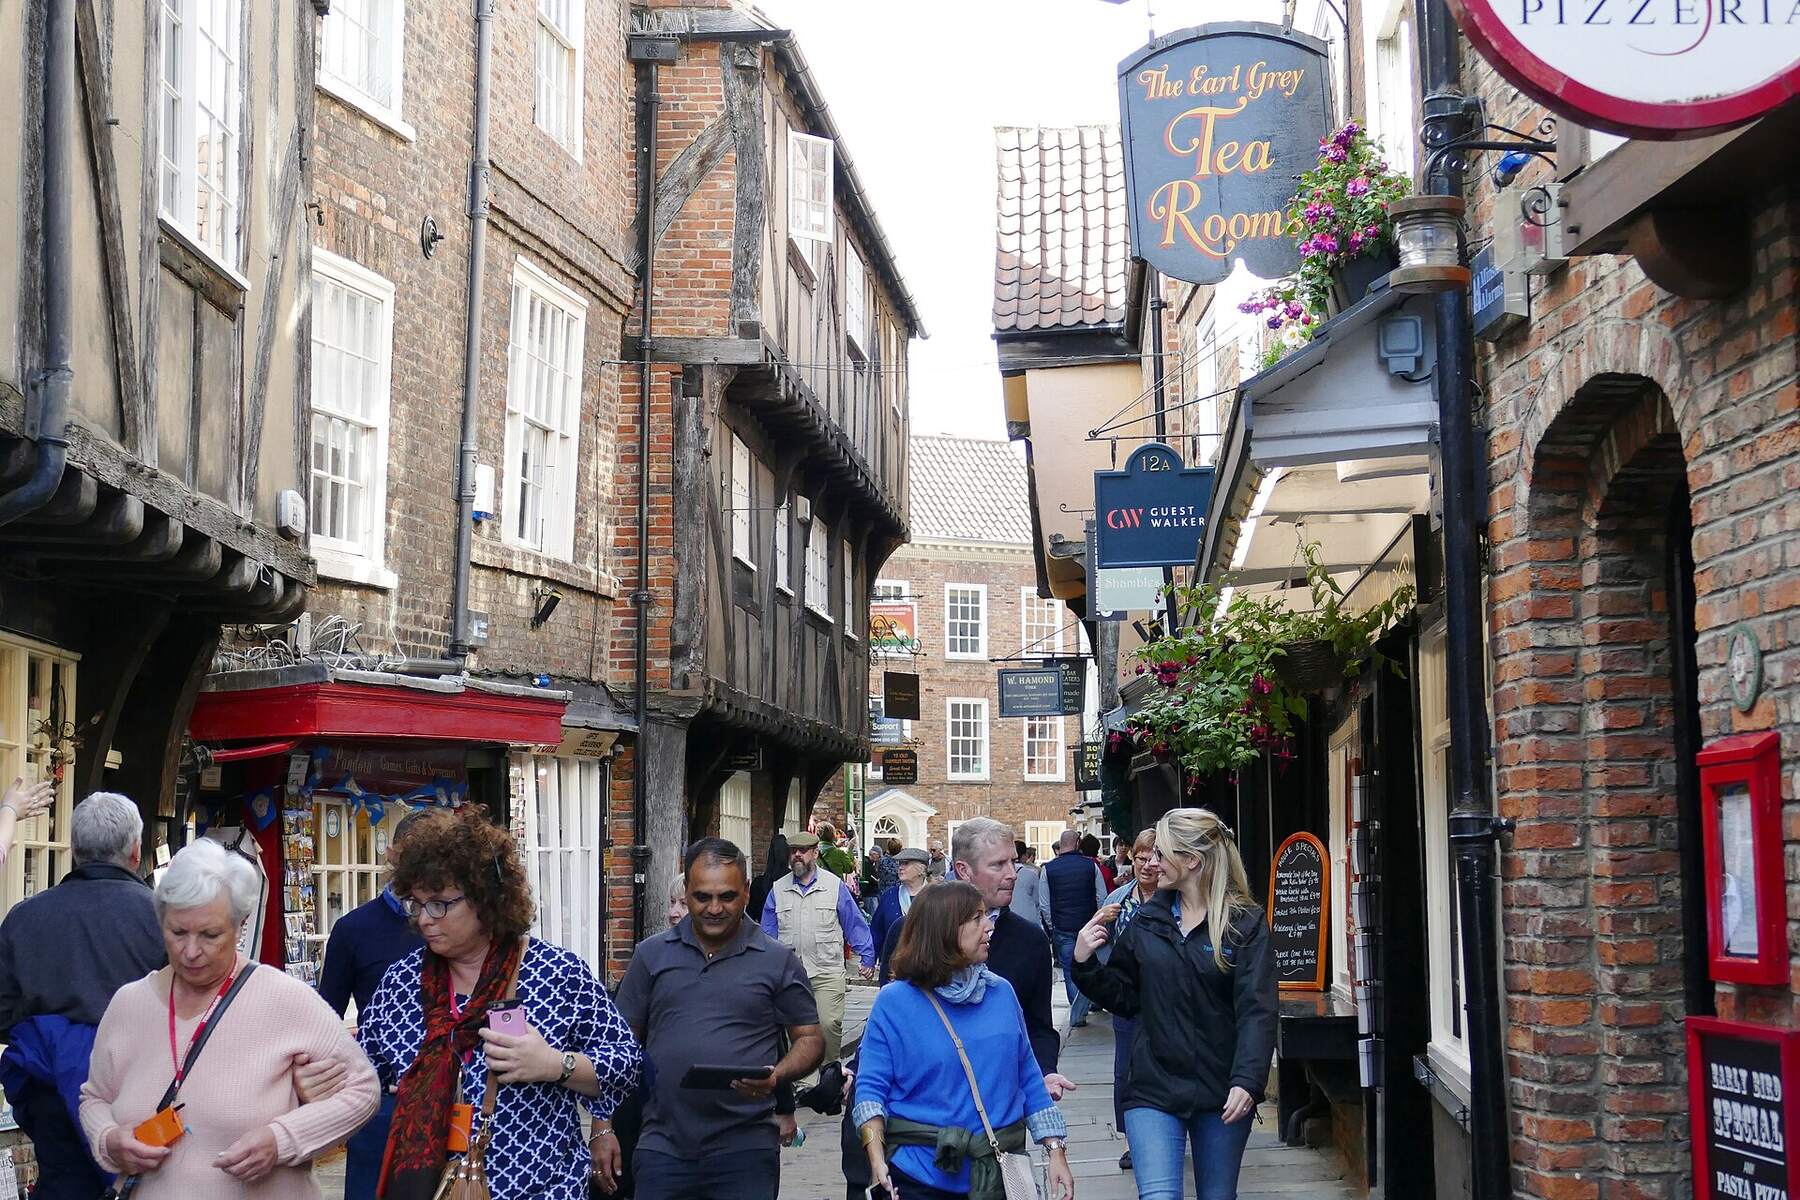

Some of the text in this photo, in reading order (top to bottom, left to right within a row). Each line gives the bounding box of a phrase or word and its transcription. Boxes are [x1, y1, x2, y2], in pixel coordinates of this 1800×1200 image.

[1139, 61, 1305, 99] The Earl Grey
[1165, 96, 1276, 179] Tea
[1142, 455, 1171, 472] 12A
[1150, 506, 1195, 517] GUEST
[1150, 517, 1205, 528] WALKER
[1019, 675, 1055, 685] HAMOND
[872, 722, 898, 731] Support
[1711, 1063, 1782, 1102] EARLY BIRD
[1713, 1097, 1784, 1152] SPECIAL
[1716, 1171, 1752, 1200] PASTA
